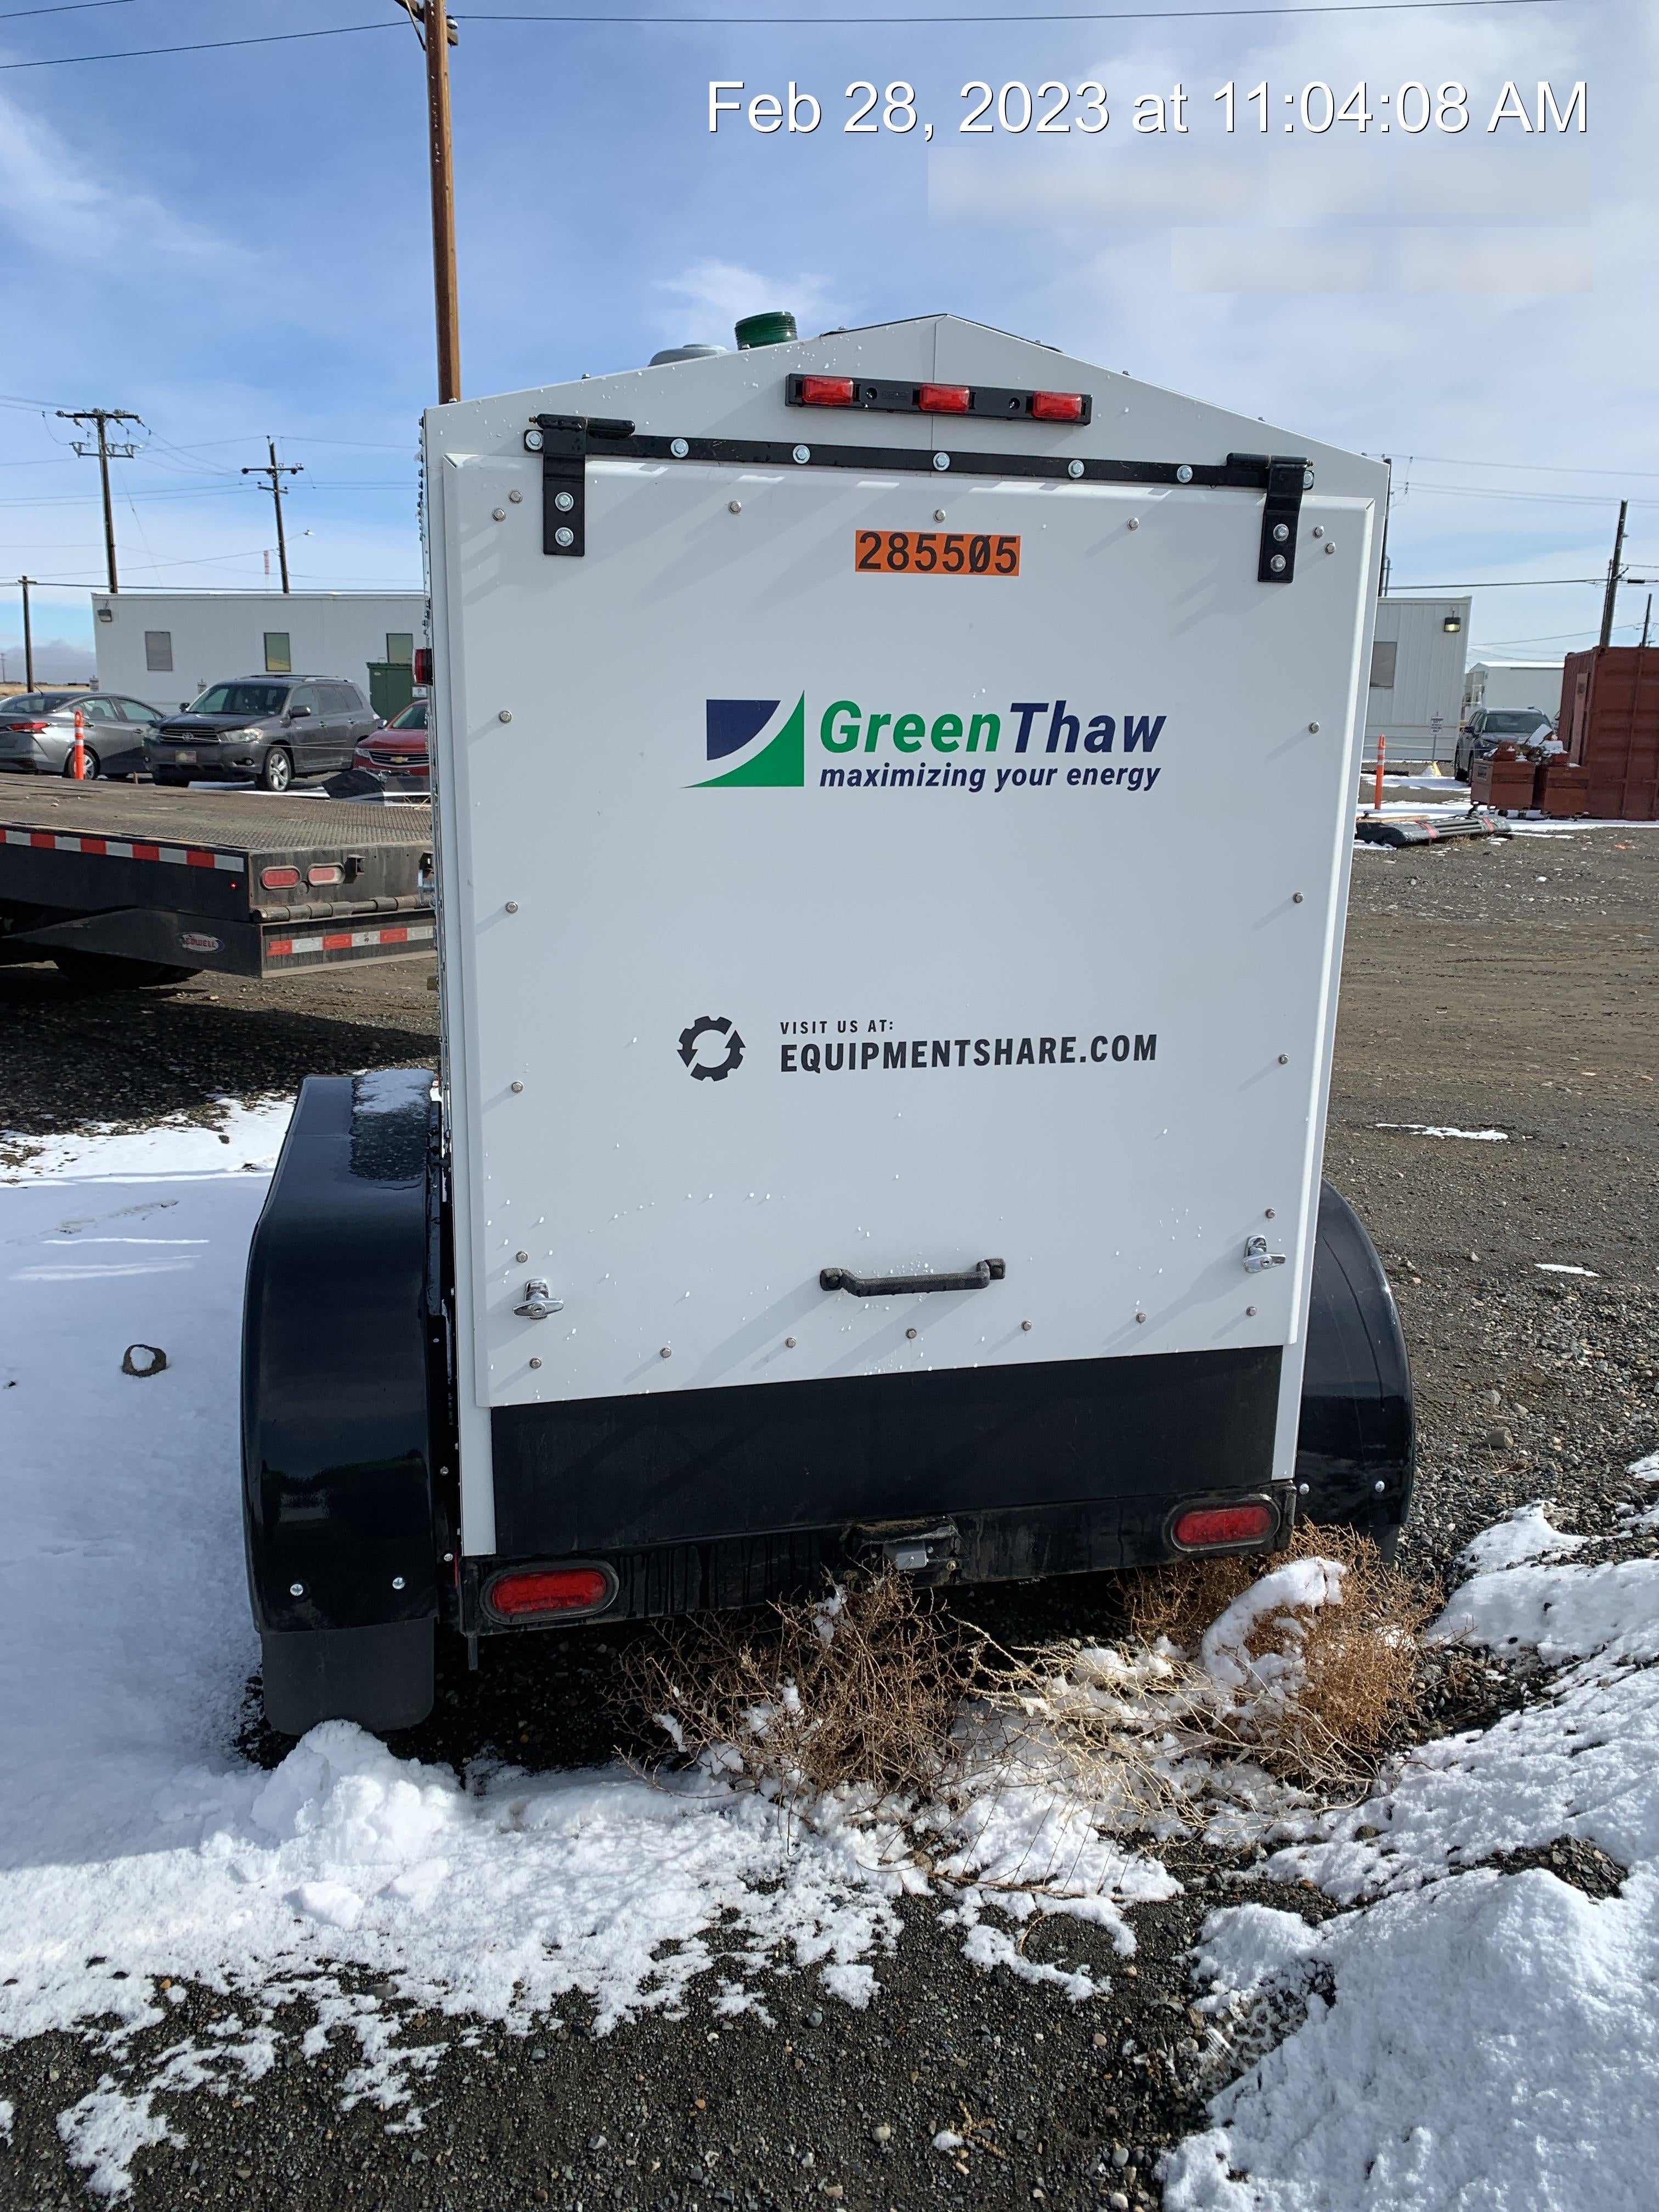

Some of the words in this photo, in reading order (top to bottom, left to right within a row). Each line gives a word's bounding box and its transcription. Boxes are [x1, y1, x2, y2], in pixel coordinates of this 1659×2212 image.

[820, 699, 1167, 754] GreenThaw
[820, 762, 986, 793] maximizing
[994, 768, 1059, 793] your
[1066, 767, 1161, 792] energy
[184, 937, 216, 948] EDWELL
[780, 1021, 828, 1035] VISIT
[837, 1020, 859, 1033] US
[867, 1019, 894, 1033] AT:
[780, 1034, 1158, 1074] EQUIPMENTSHARE.COM
